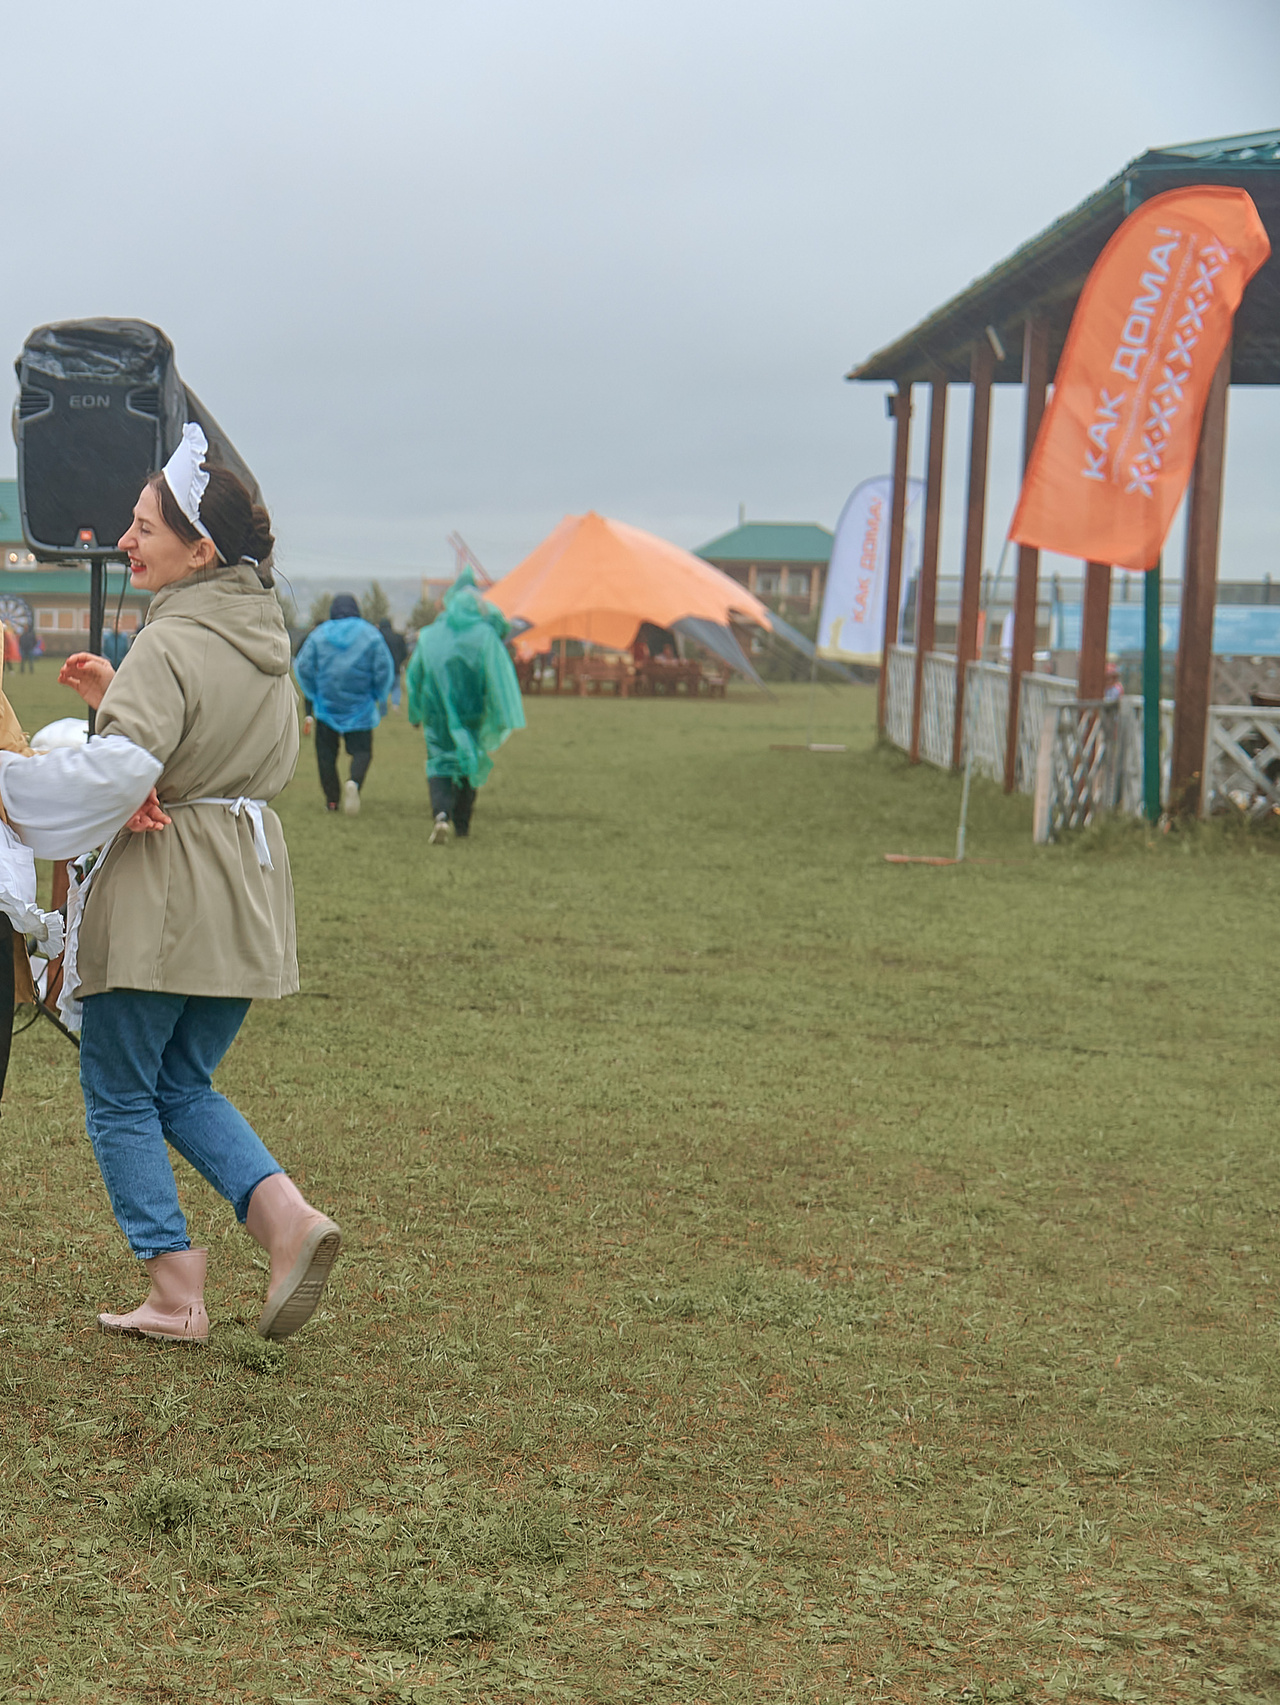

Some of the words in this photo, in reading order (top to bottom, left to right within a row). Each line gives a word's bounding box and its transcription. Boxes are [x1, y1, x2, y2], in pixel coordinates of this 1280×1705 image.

[70, 394, 111, 409] EON
[1081, 388, 1126, 481] КАК
[1110, 227, 1182, 381] ДОМА!
